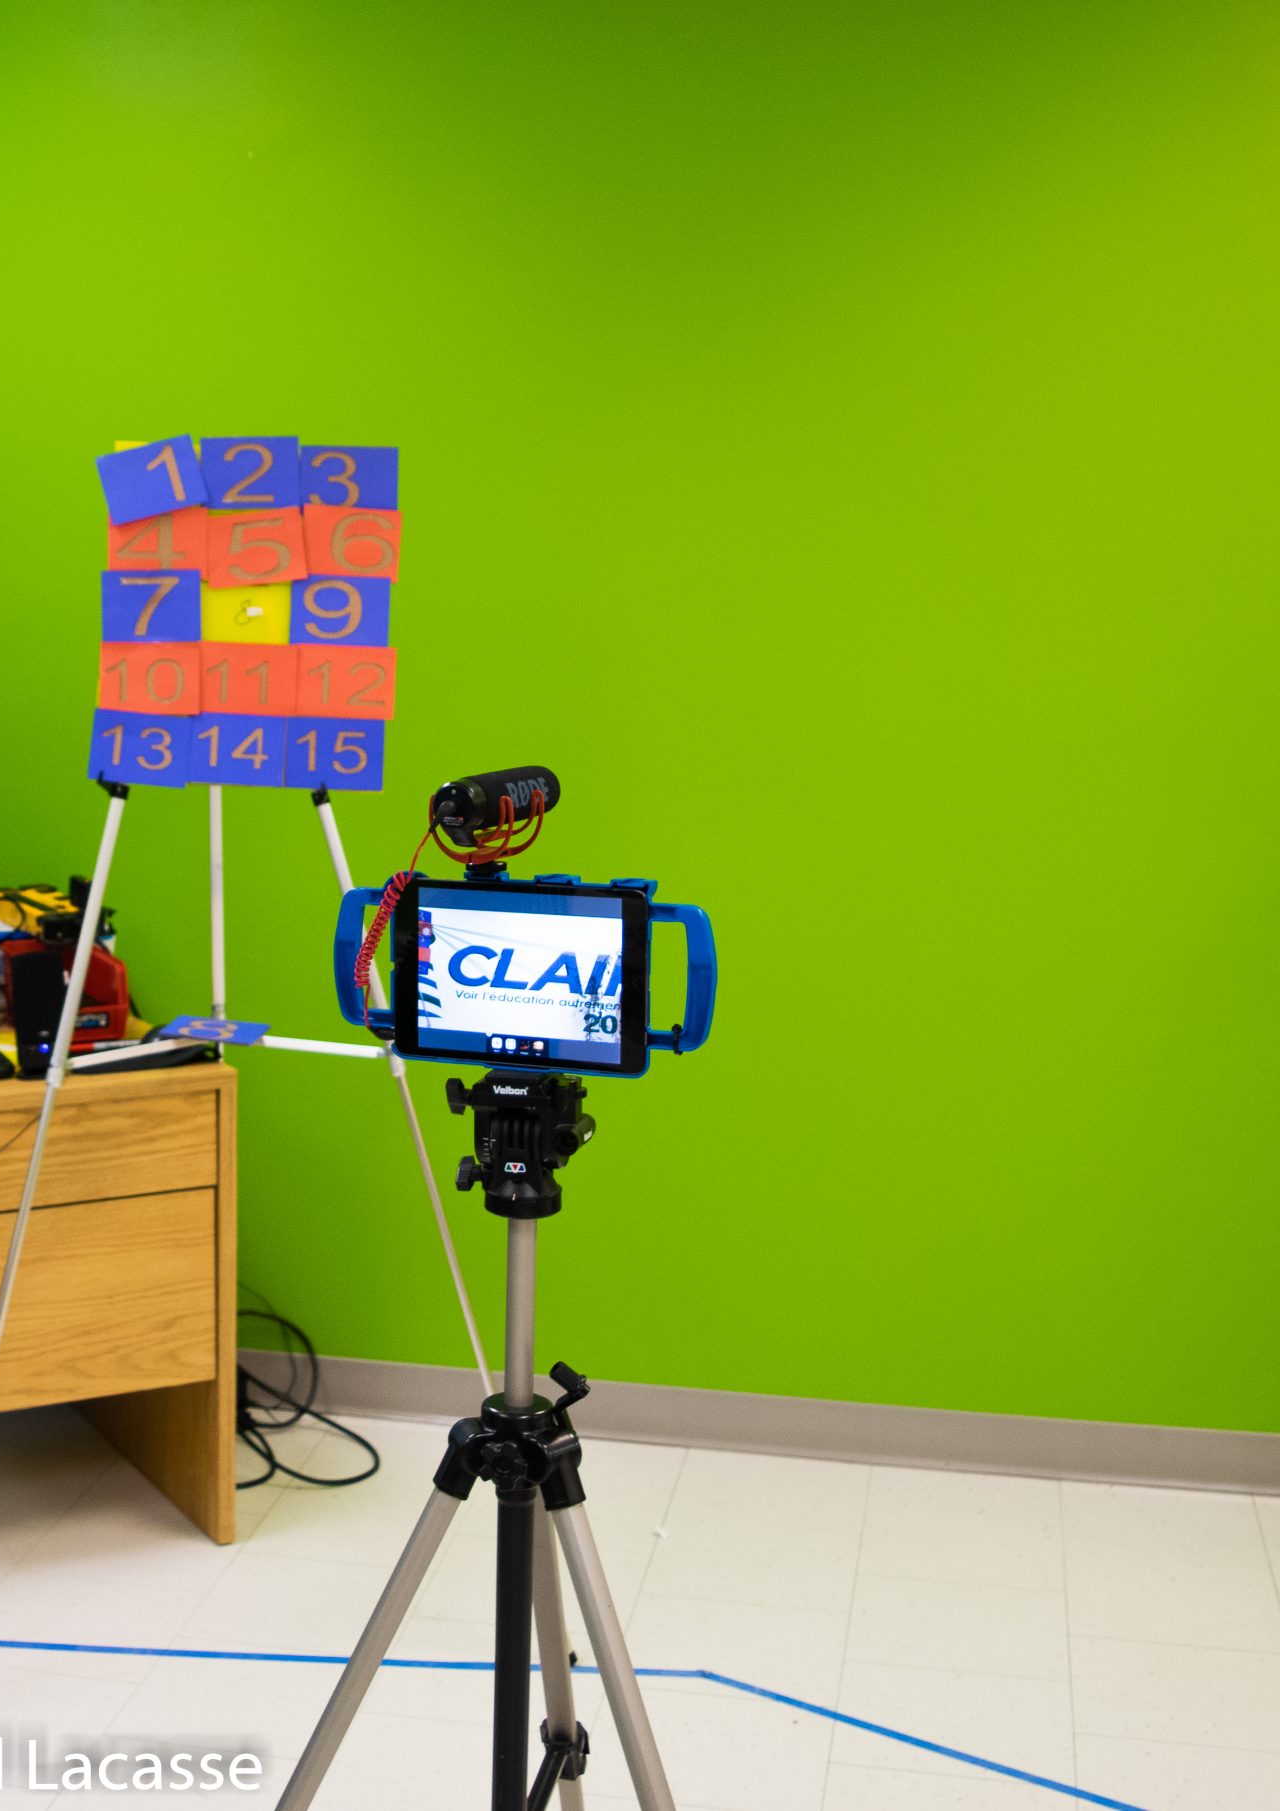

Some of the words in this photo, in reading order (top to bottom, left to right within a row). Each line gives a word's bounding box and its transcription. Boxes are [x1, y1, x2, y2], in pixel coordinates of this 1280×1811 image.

[146, 445, 186, 501] 1
[222, 443, 274, 503] 2
[308, 451, 360, 507] 3
[115, 514, 186, 569] 4
[227, 517, 291, 580] 5
[331, 512, 396, 574] 6
[120, 576, 179, 636] 7
[303, 579, 363, 639] 9
[105, 658, 185, 704] 10
[206, 659, 269, 705] 11
[308, 660, 387, 707] 12
[102, 725, 172, 770] 13
[197, 725, 269, 769] 14
[296, 729, 369, 775] 15
[455, 988, 479, 1000] Voir
[482, 991, 555, 1006] l'éducation
[177, 1020, 239, 1040] 8
[583, 1013, 619, 1035] 20
[492, 1084, 528, 1096] Velbon
